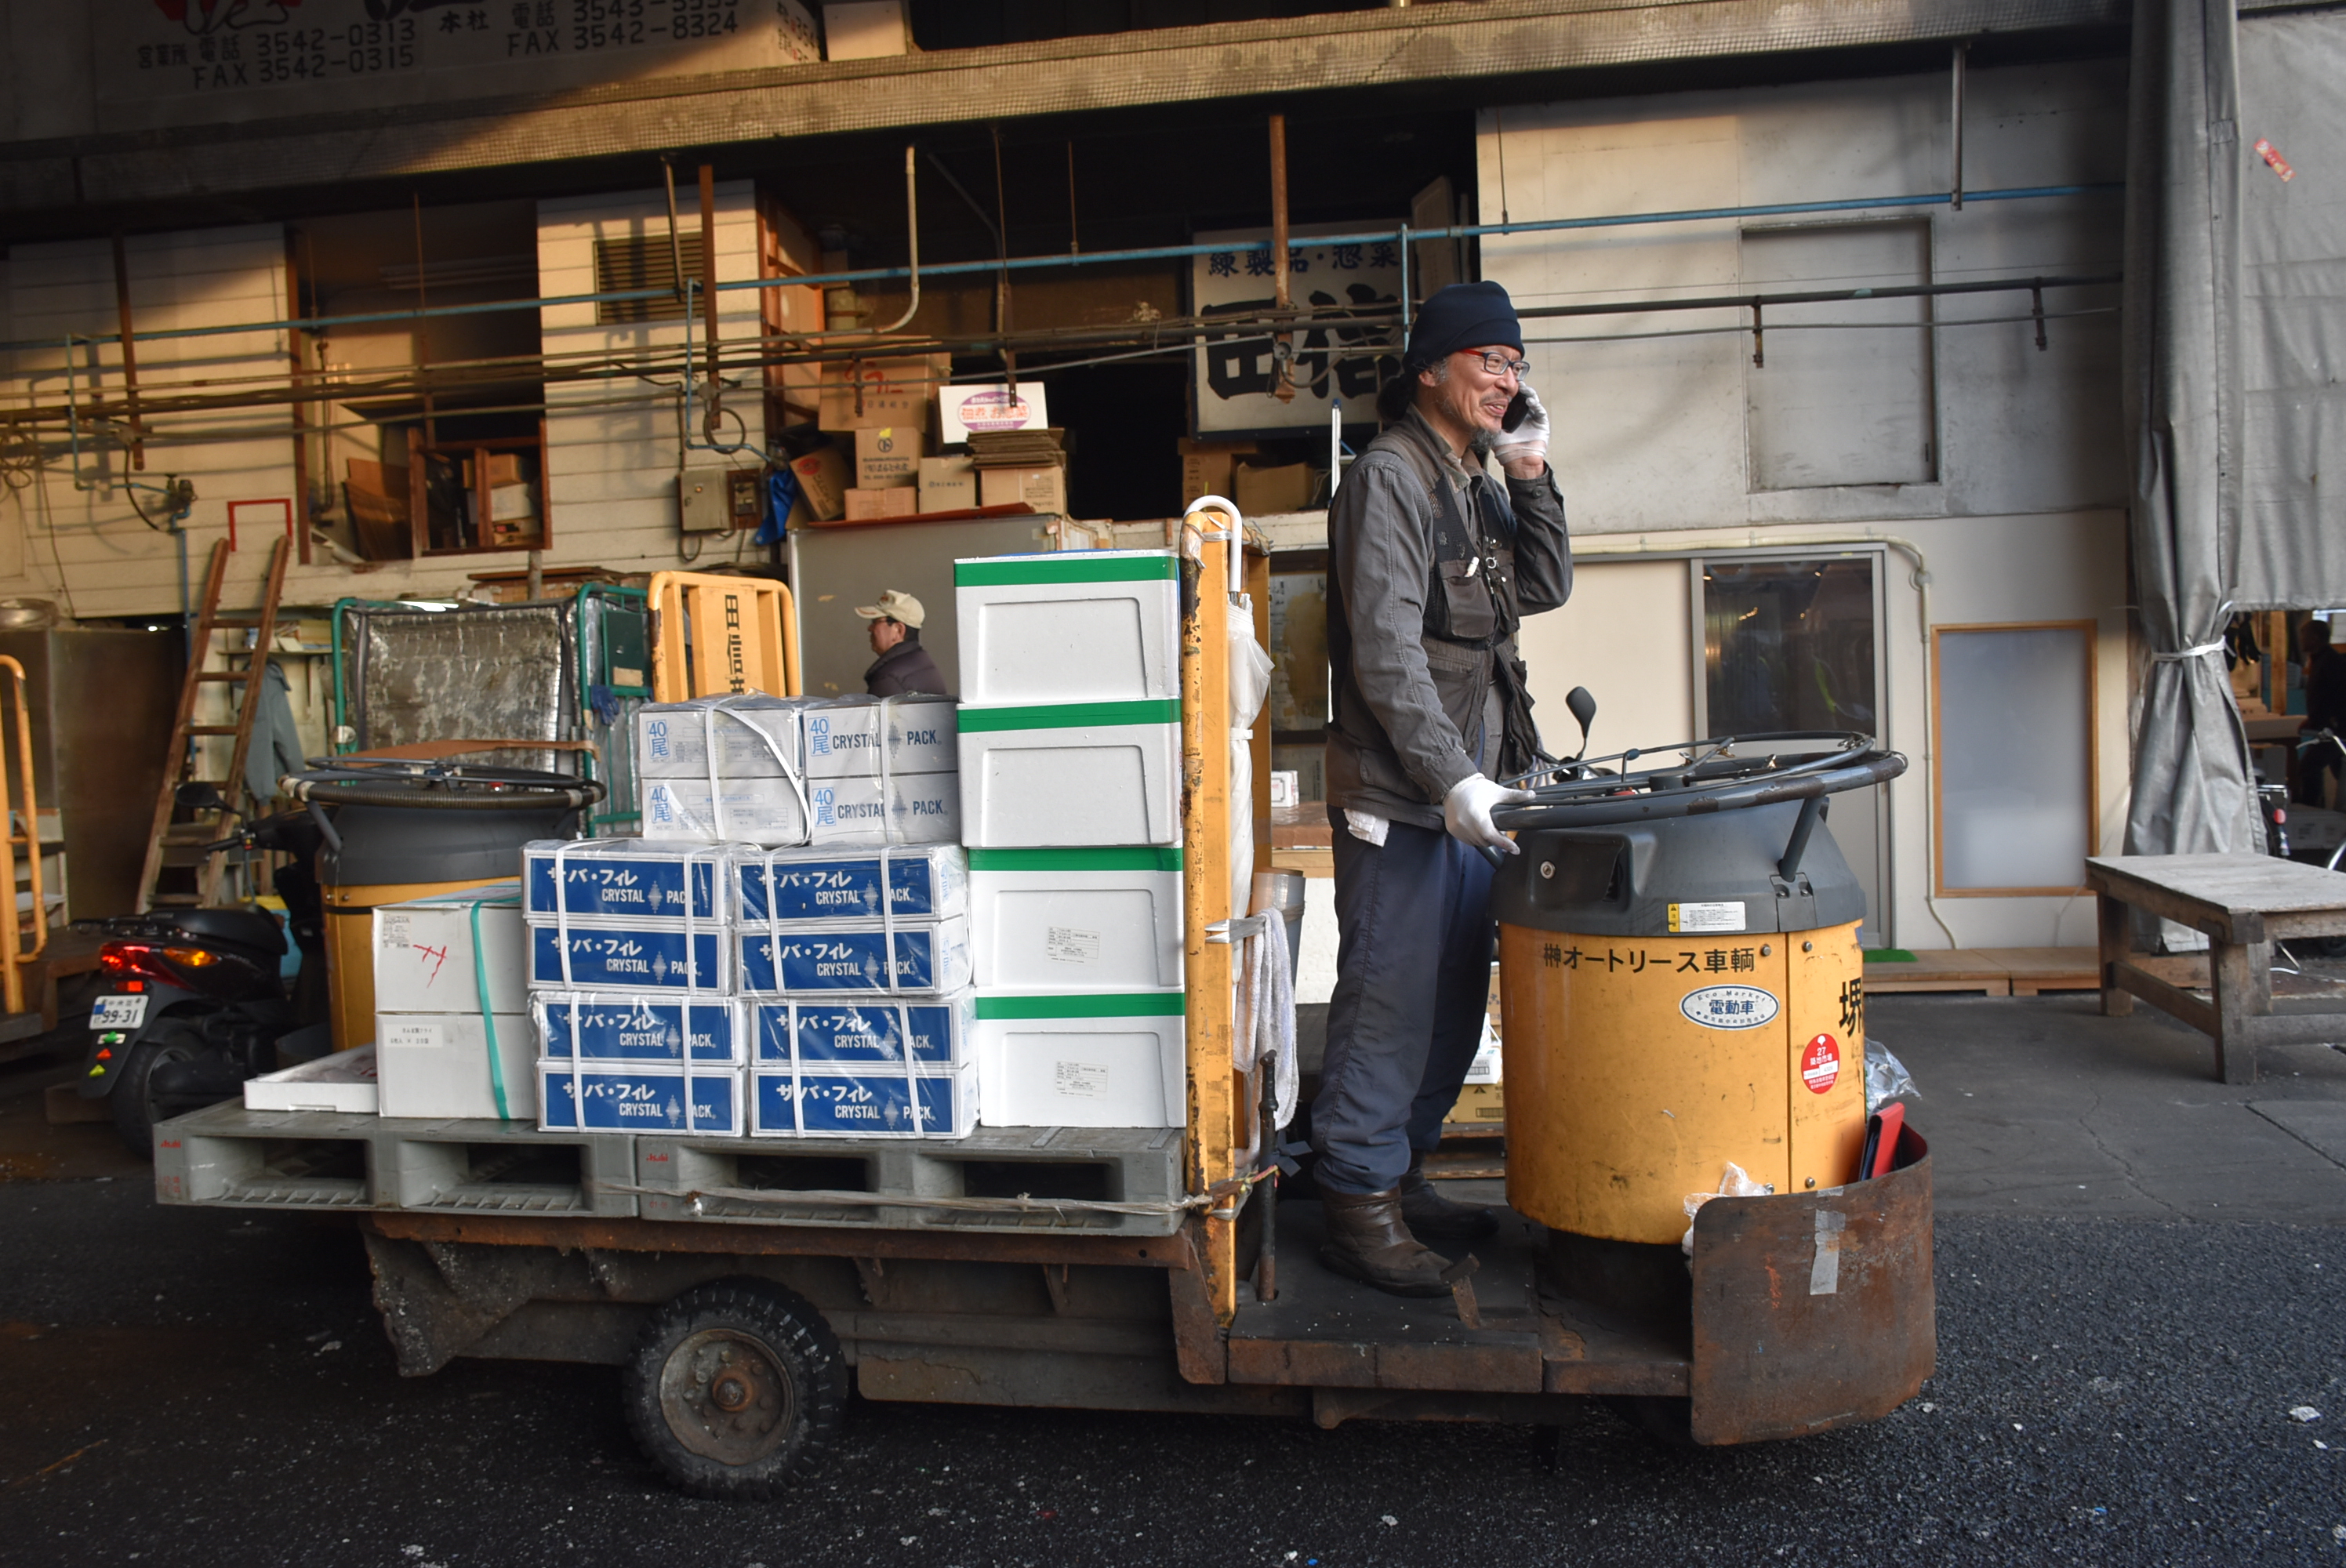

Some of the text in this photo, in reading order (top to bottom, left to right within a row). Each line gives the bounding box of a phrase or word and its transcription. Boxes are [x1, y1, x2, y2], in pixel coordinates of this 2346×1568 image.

[440, 10, 489, 34] 本社
[512, 1, 555, 29] 電話
[198, 34, 240, 62] 電話
[256, 18, 416, 56] 3542-0313
[507, 28, 560, 56] FAX
[573, 10, 738, 50] 3542-8324
[192, 44, 414, 89] FAX 3542-0315
[648, 721, 666, 738] 40
[810, 718, 829, 735] 40
[651, 738, 669, 757] 尾
[812, 735, 830, 755] 尾
[833, 730, 937, 750] CRYSTAL PACK
[651, 786, 668, 803] 40
[815, 789, 833, 806] 40
[653, 803, 671, 823] 尾
[816, 806, 835, 826] 尾
[913, 800, 943, 815] PACK
[602, 889, 686, 904] CRYSTAL PAC
[815, 887, 910, 905] CRYSTAL ACK
[606, 958, 649, 973] CRYSTAL
[817, 961, 912, 977] CRYSTAL PCK
[1697, 990, 1765, 1002] Eco Market
[102, 1009, 138, 1023] 99-31
[1709, 1000, 1755, 1015] 電動車
[619, 1033, 711, 1047] CRYSTAL ACK
[834, 1034, 930, 1049] CRYSTAL ACK
[1817, 1047, 1826, 1056] 27
[776, 1084, 873, 1102] サバ・フィレ
[619, 1103, 711, 1118] CRYSTAL ACK
[835, 1105, 880, 1120] CRYSTAL
